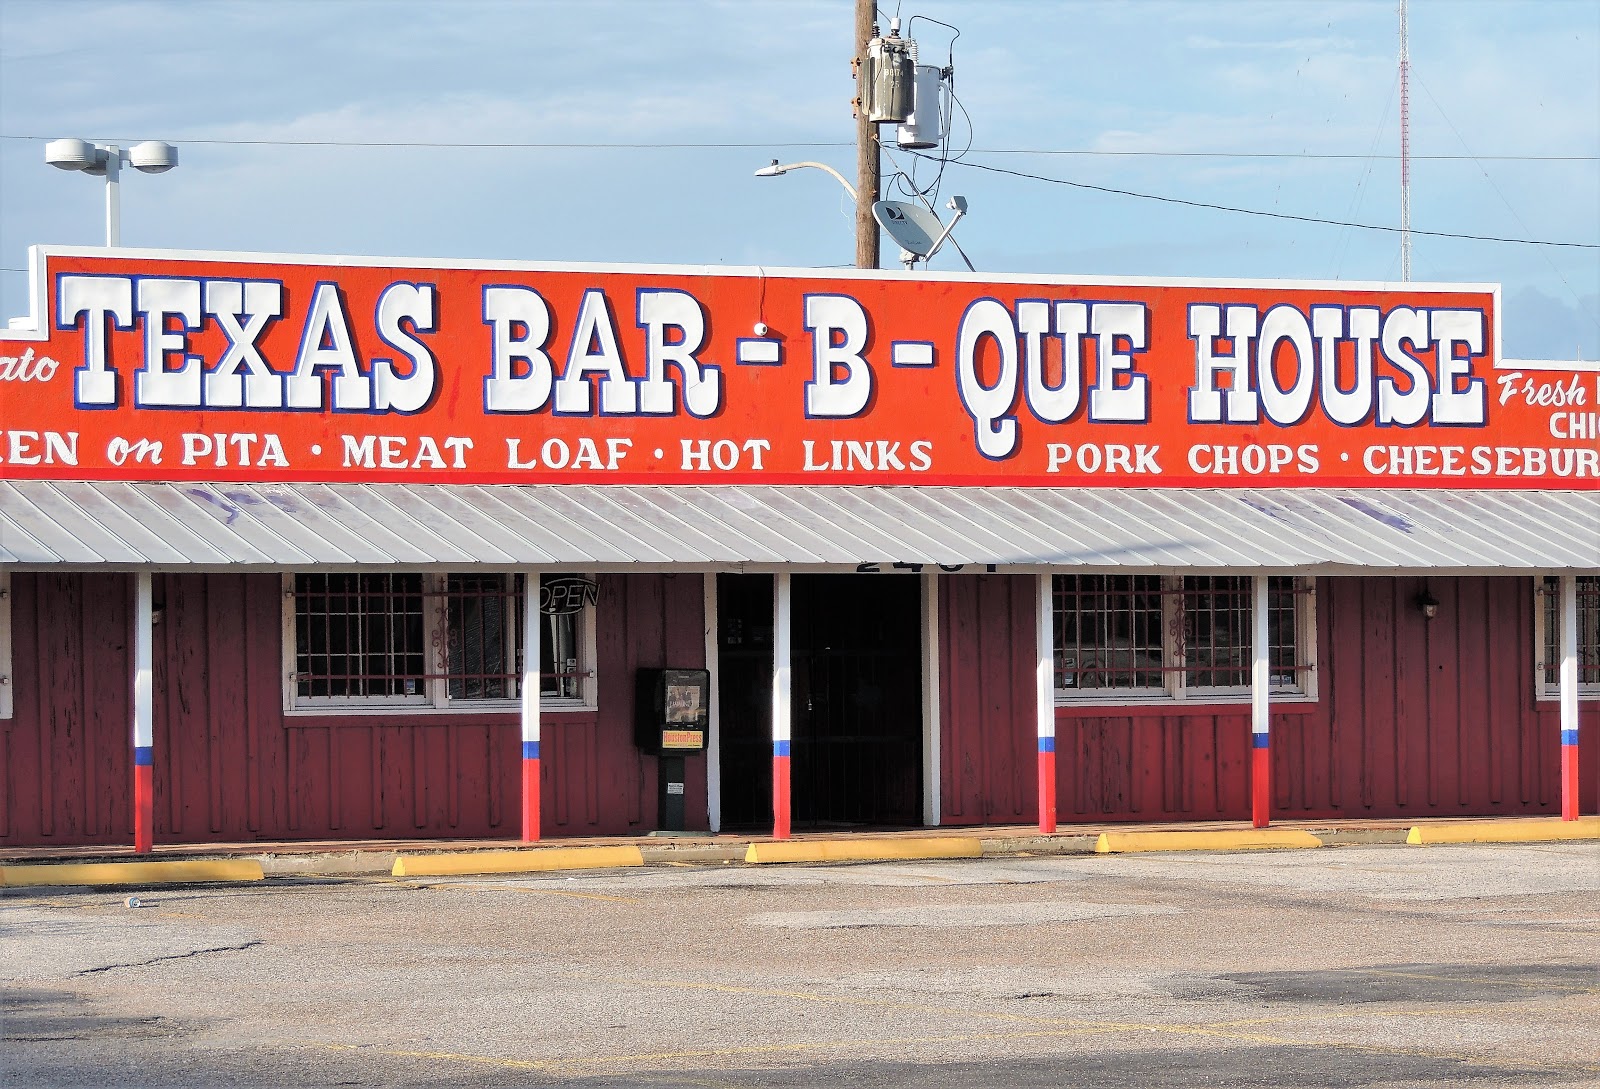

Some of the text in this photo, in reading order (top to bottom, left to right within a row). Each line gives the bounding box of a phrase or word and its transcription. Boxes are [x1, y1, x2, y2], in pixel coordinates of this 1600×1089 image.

[0, 347, 59, 381] ato
[57, 274, 436, 413] TEXAS
[1189, 304, 1484, 426] HOUSE
[1497, 372, 1586, 406] Fresh
[1550, 412, 1600, 439] CHI
[0, 431, 78, 465] EN
[107, 437, 162, 466] on
[182, 433, 289, 466] PITA
[341, 435, 473, 468] MEAT
[506, 438, 632, 469] LOAF
[681, 440, 770, 470] HOT
[803, 440, 932, 471] LINKS
[1047, 443, 1162, 474] PORK
[1188, 444, 1319, 474] CHOPS
[1364, 445, 1600, 477] CHEESEBUR
